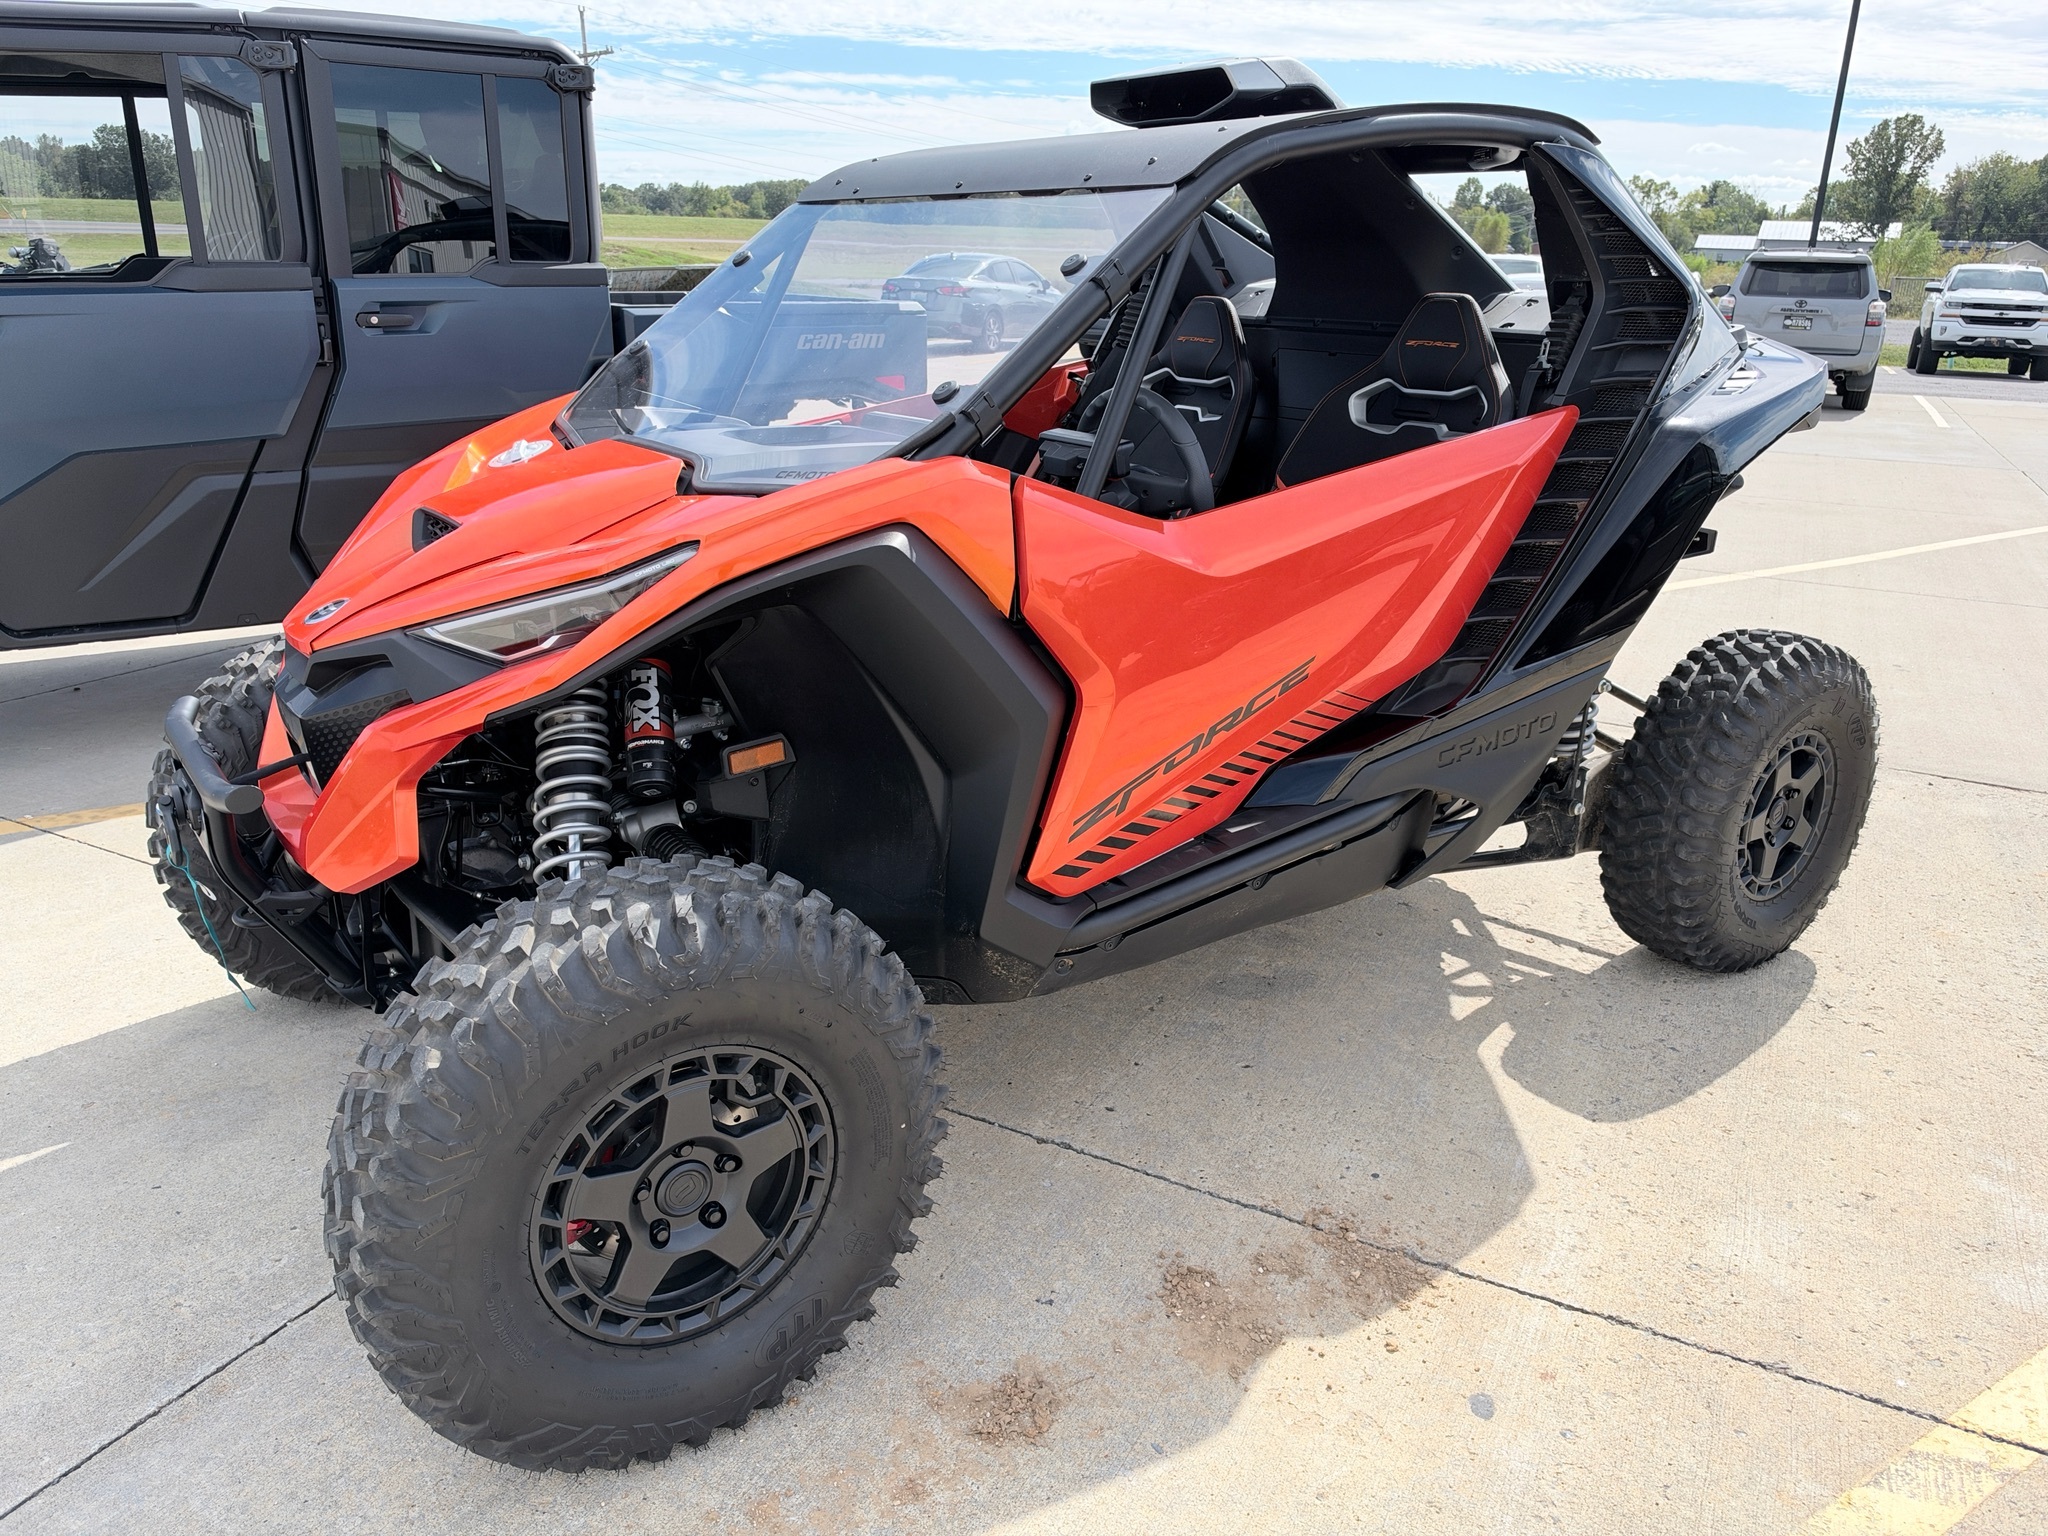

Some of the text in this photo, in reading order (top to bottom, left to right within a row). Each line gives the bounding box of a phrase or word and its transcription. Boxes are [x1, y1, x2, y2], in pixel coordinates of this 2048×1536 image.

[796, 332, 885, 350] can-am
[1405, 339, 1460, 349] ZFORCE
[625, 667, 661, 733] FOX
[1067, 654, 1318, 845] ZFORCE
[1437, 710, 1558, 769] CFMOTO
[514, 1011, 694, 1156] TERRA HOOK
[766, 1297, 825, 1363] ITP
